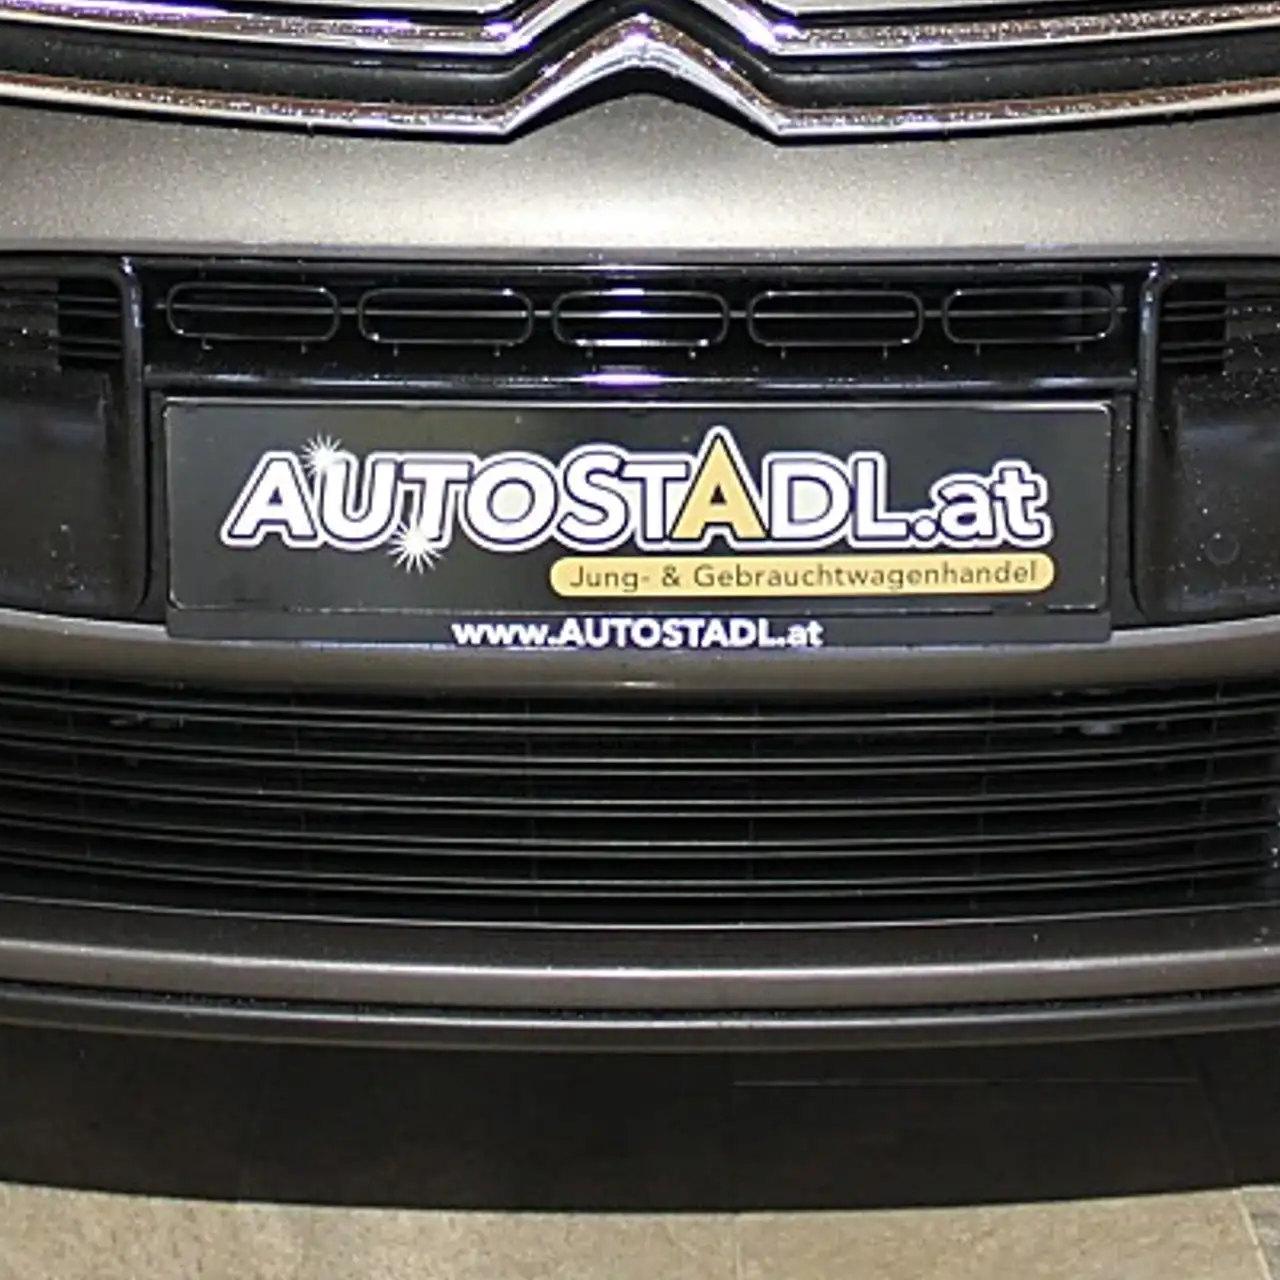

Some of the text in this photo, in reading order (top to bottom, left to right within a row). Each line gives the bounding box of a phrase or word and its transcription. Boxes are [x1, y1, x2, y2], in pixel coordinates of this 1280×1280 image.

[222, 427, 1053, 552] AUTOSTADL.at
[568, 560, 1038, 591] Jung- & Gebrauchtwagenhandel
[452, 617, 824, 649] www.AUTOSTADL.at
